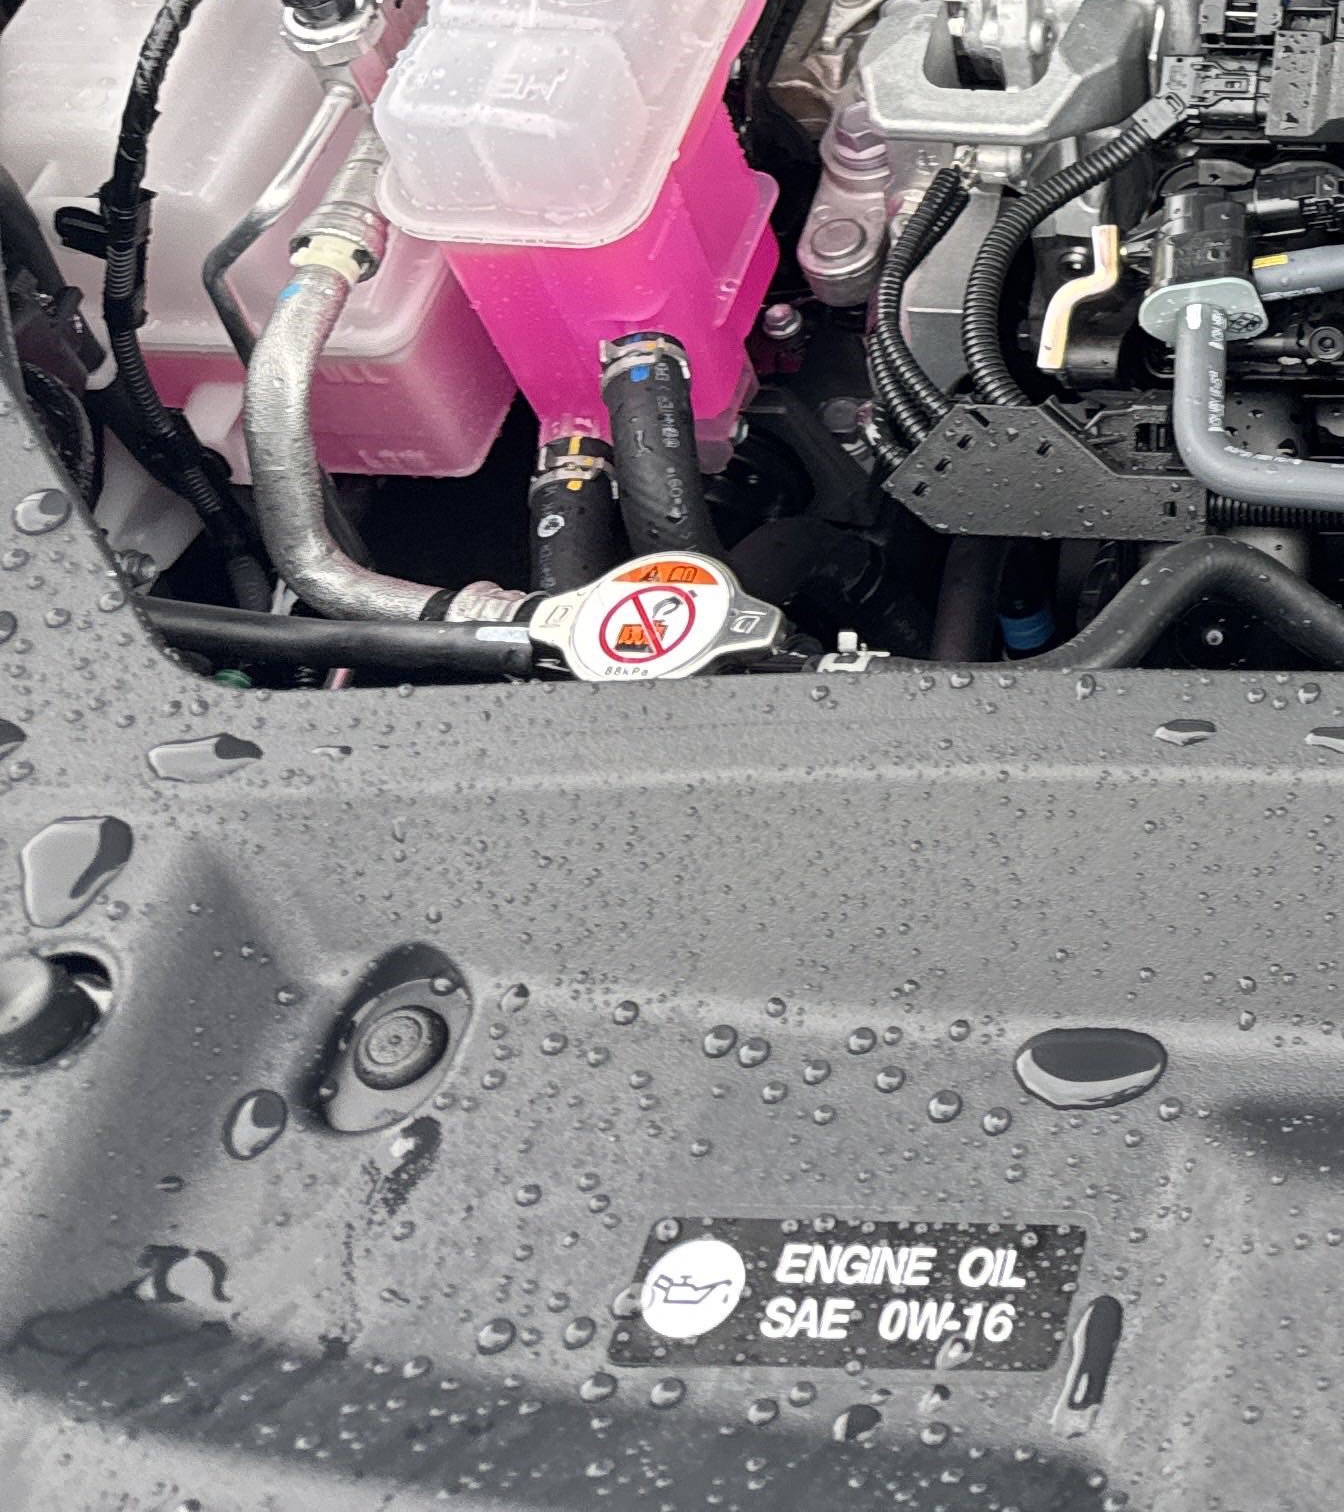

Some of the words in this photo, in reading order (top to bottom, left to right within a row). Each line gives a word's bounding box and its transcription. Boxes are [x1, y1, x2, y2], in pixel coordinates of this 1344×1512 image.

[604, 665, 649, 677] 88kPa
[775, 1244, 938, 1286] ENGINE
[957, 1247, 1027, 1288] OIL
[759, 1296, 856, 1340] SAE
[877, 1298, 1017, 1343] 0W-16
